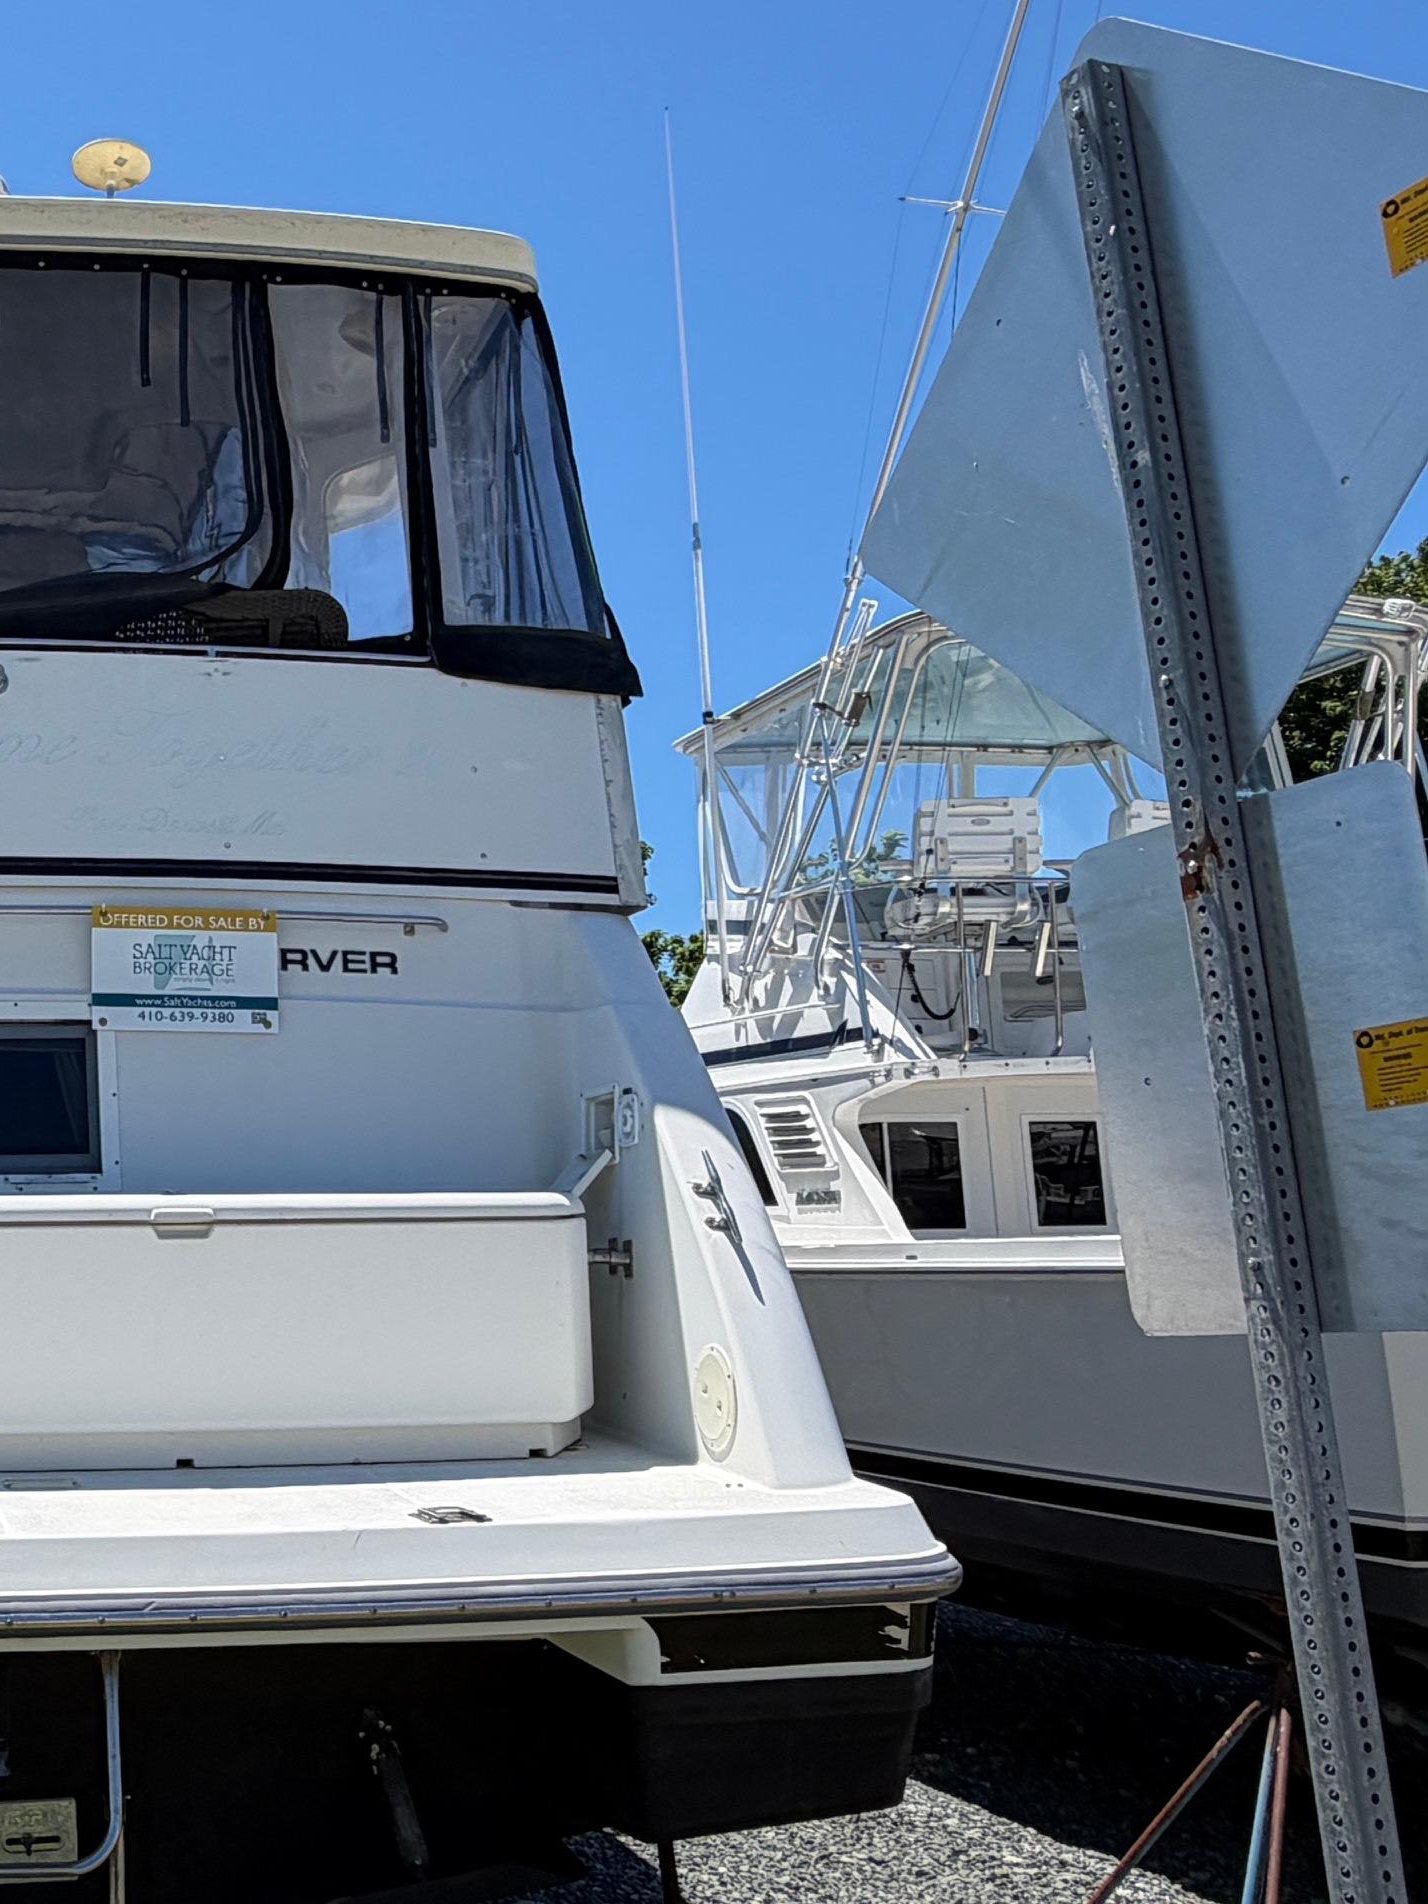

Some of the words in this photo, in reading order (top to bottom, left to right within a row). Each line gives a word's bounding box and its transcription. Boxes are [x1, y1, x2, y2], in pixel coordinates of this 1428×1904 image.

[99, 912, 168, 928] OFFERED
[173, 916, 205, 929] FOR
[208, 916, 245, 930] SALE
[248, 917, 267, 931] BY
[132, 942, 178, 961] SALT
[179, 943, 238, 962] YACHT
[132, 961, 235, 977] BROKERAGE
[280, 948, 399, 975] RVER
[134, 996, 237, 1009] www.SaltYachts.com
[137, 1010, 235, 1024] 410-639-9380
